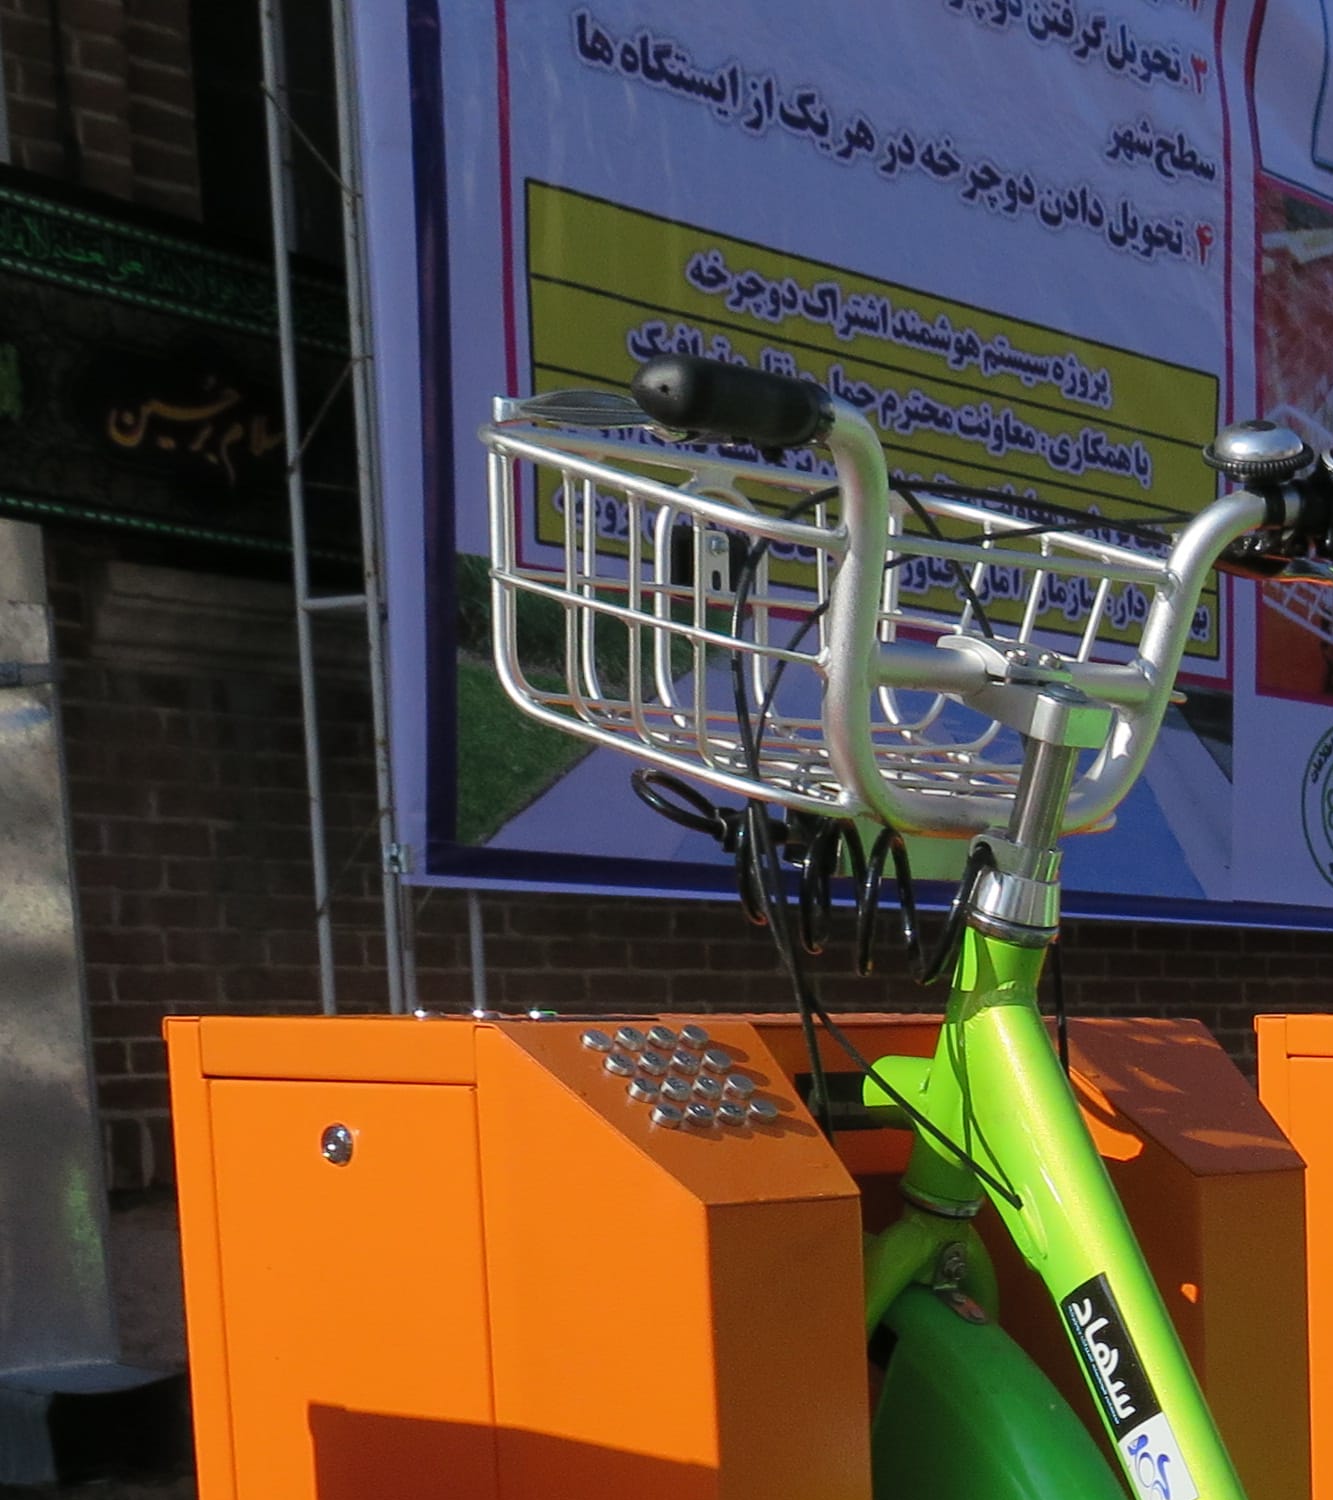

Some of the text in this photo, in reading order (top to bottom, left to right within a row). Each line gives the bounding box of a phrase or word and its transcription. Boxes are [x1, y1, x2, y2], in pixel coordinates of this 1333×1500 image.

[1107, 24, 1182, 83] تحویل
[744, 80, 773, 130] از
[780, 93, 830, 149] یک
[837, 119, 875, 158] هر
[881, 133, 915, 175] در
[1105, 120, 1216, 182] سطح شهر
[1040, 187, 1103, 227] دادن
[1109, 201, 1182, 258] تحویل
[803, 284, 889, 336] اشتراک
[893, 316, 980, 369] هوشمند
[983, 338, 1049, 381] سیستم
[1052, 352, 1109, 406] پروژه
[879, 390, 953, 432] محترم
[958, 405, 1035, 452] معاونت
